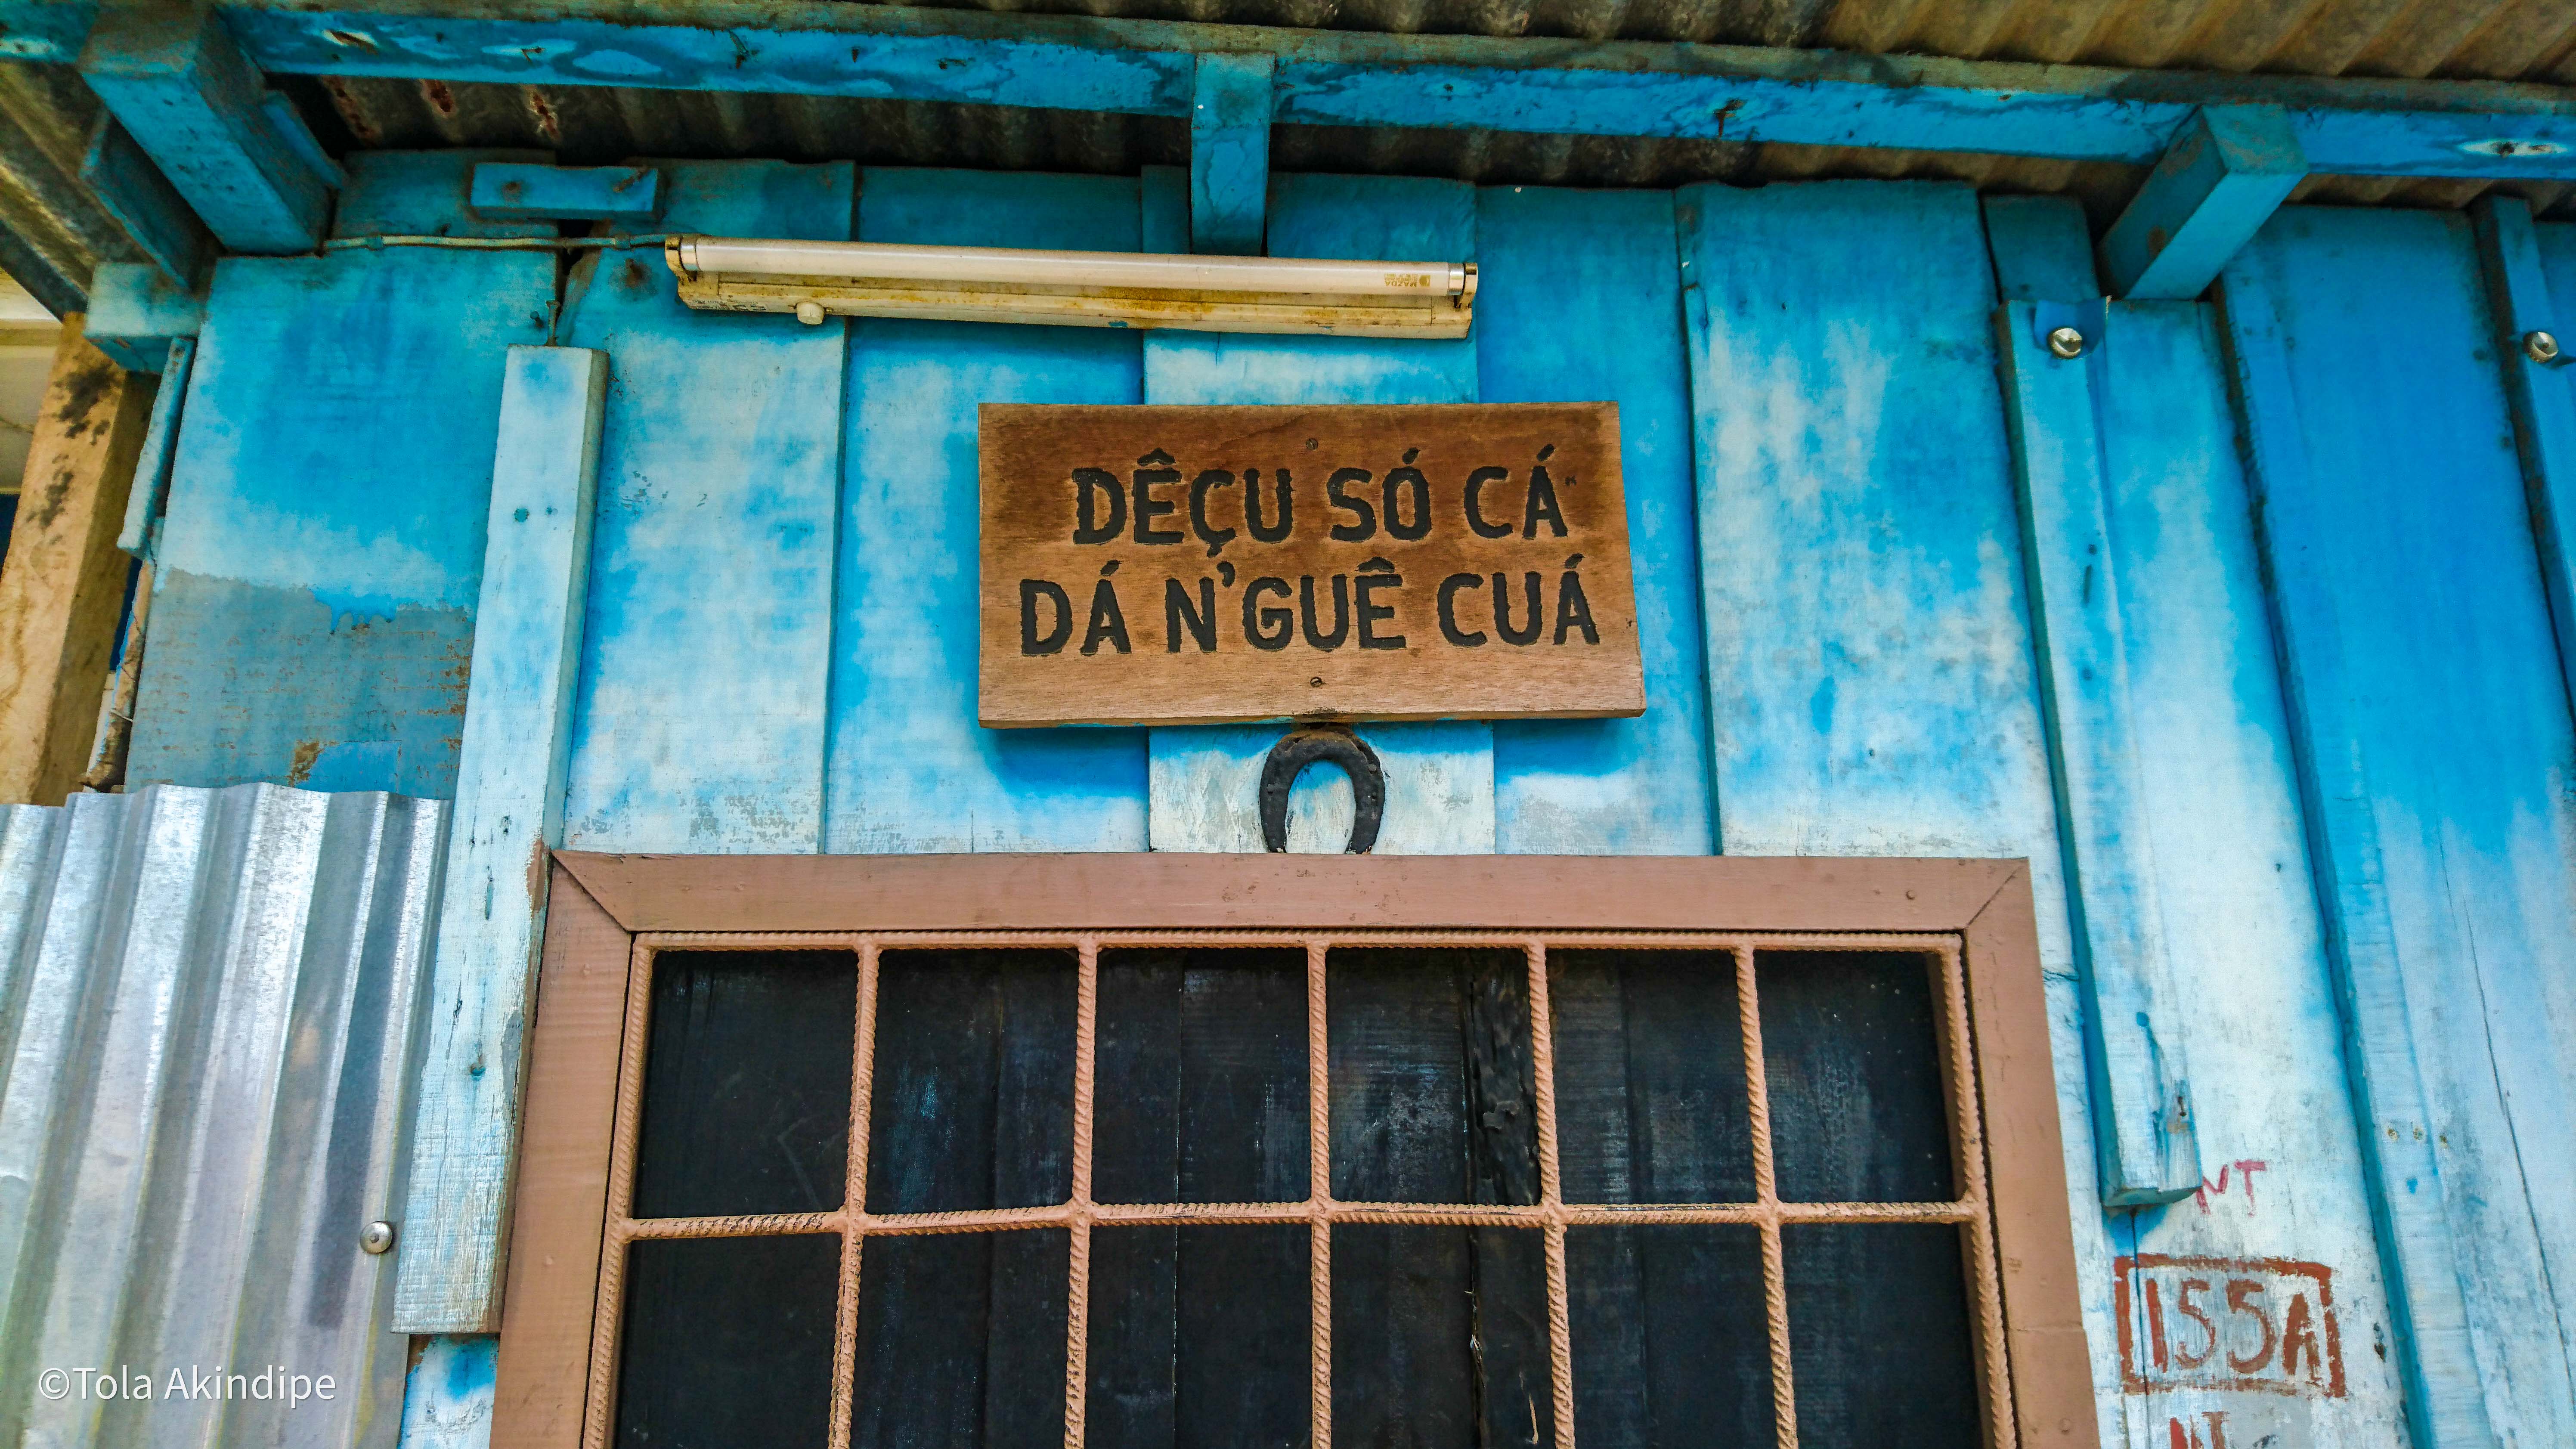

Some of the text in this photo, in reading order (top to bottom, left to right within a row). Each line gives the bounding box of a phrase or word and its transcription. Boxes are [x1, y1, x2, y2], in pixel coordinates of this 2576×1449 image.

[1071, 443, 1568, 557] DÊÇU SÓ CÁ
[1020, 553, 1600, 656] DÁ N'GUÊ CUÁ
